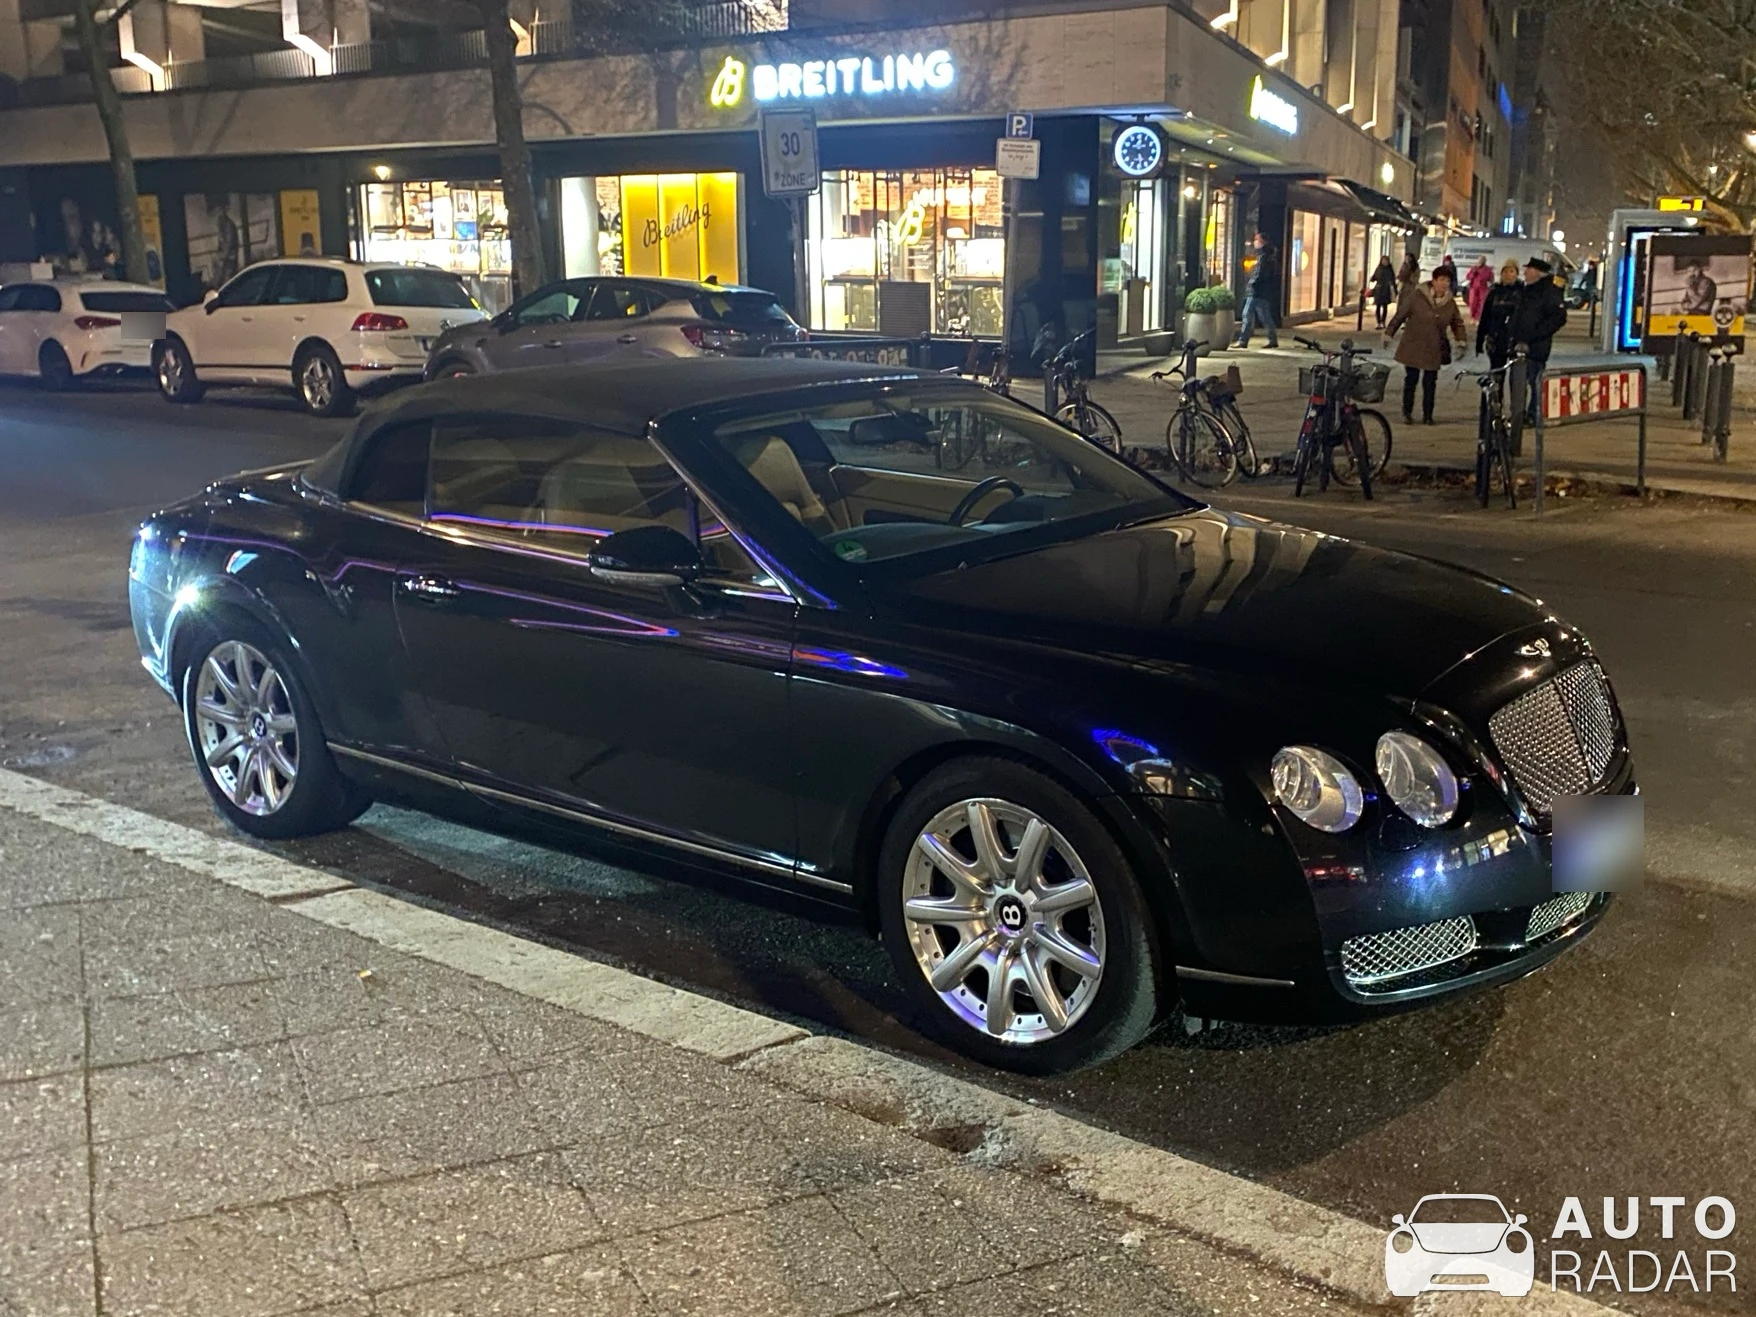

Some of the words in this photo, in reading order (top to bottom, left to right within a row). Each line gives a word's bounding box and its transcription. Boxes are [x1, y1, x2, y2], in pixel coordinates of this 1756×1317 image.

[753, 50, 954, 101] BREITLING
[1012, 115, 1027, 136] P
[781, 132, 800, 157] 30
[781, 172, 806, 188] ZONE
[643, 202, 712, 248] Breitling
[1002, 905, 1021, 926] B
